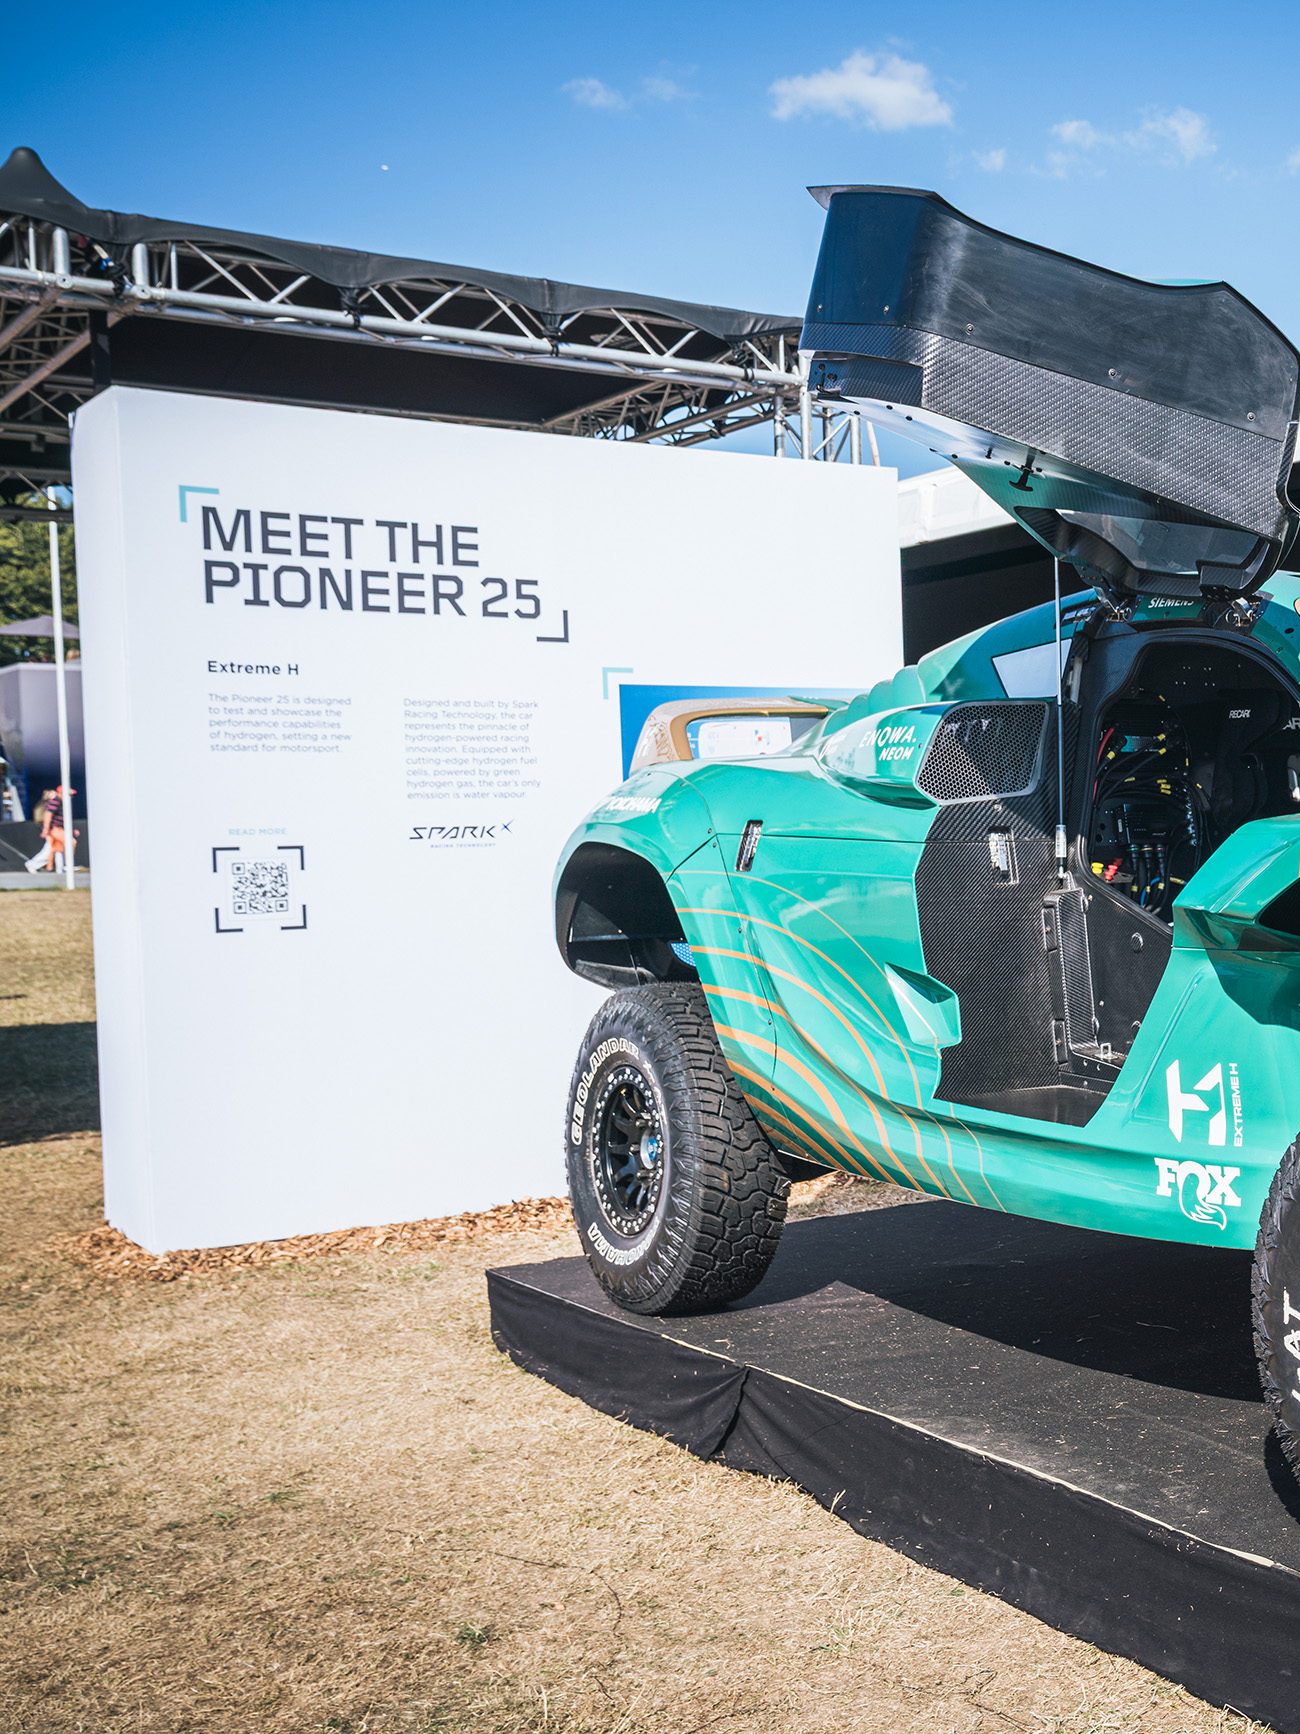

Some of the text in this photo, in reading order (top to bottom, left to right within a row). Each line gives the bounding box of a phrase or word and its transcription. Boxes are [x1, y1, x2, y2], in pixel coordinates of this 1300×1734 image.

[202, 505, 480, 567] MEET THE
[204, 560, 541, 619] PIONEER 25
[207, 660, 300, 676] Extreme H
[208, 692, 228, 702] The
[232, 693, 273, 703] Pioneer
[303, 695, 351, 707] designed
[403, 697, 450, 709] Designed
[452, 698, 471, 707] and
[473, 698, 495, 708] built
[512, 699, 539, 711] Spark
[223, 705, 244, 715] test
[247, 705, 267, 715] and
[271, 706, 322, 716] showcase
[325, 707, 341, 717] the
[404, 709, 438, 721] Racing
[500, 709, 516, 719] the
[208, 718, 341, 731] performance capabilities
[404, 720, 456, 732] represents
[459, 721, 474, 730] the
[477, 721, 517, 733] pinnacle
[282, 730, 318, 742] setting
[500, 732, 529, 744] racing
[210, 742, 258, 752] standard
[261, 742, 276, 752] for
[462, 743, 508, 755] Equipped
[510, 743, 530, 753] with
[472, 755, 517, 766] hydrogen
[520, 755, 537, 764] fuel
[878, 747, 914, 761] NEOM
[433, 766, 476, 778] powered
[493, 769, 520, 778] green
[406, 778, 453, 790] hydrogen
[478, 777, 494, 787] the
[521, 777, 541, 789] only
[407, 789, 450, 799] emission
[463, 789, 490, 799] water
[228, 827, 287, 836] READ MORE
[409, 825, 497, 840] SPARK
[571, 1037, 641, 1146] GEOLANDAR
[1229, 1062, 1243, 1147] EXTREME H
[1153, 1157, 1241, 1230] FOX
